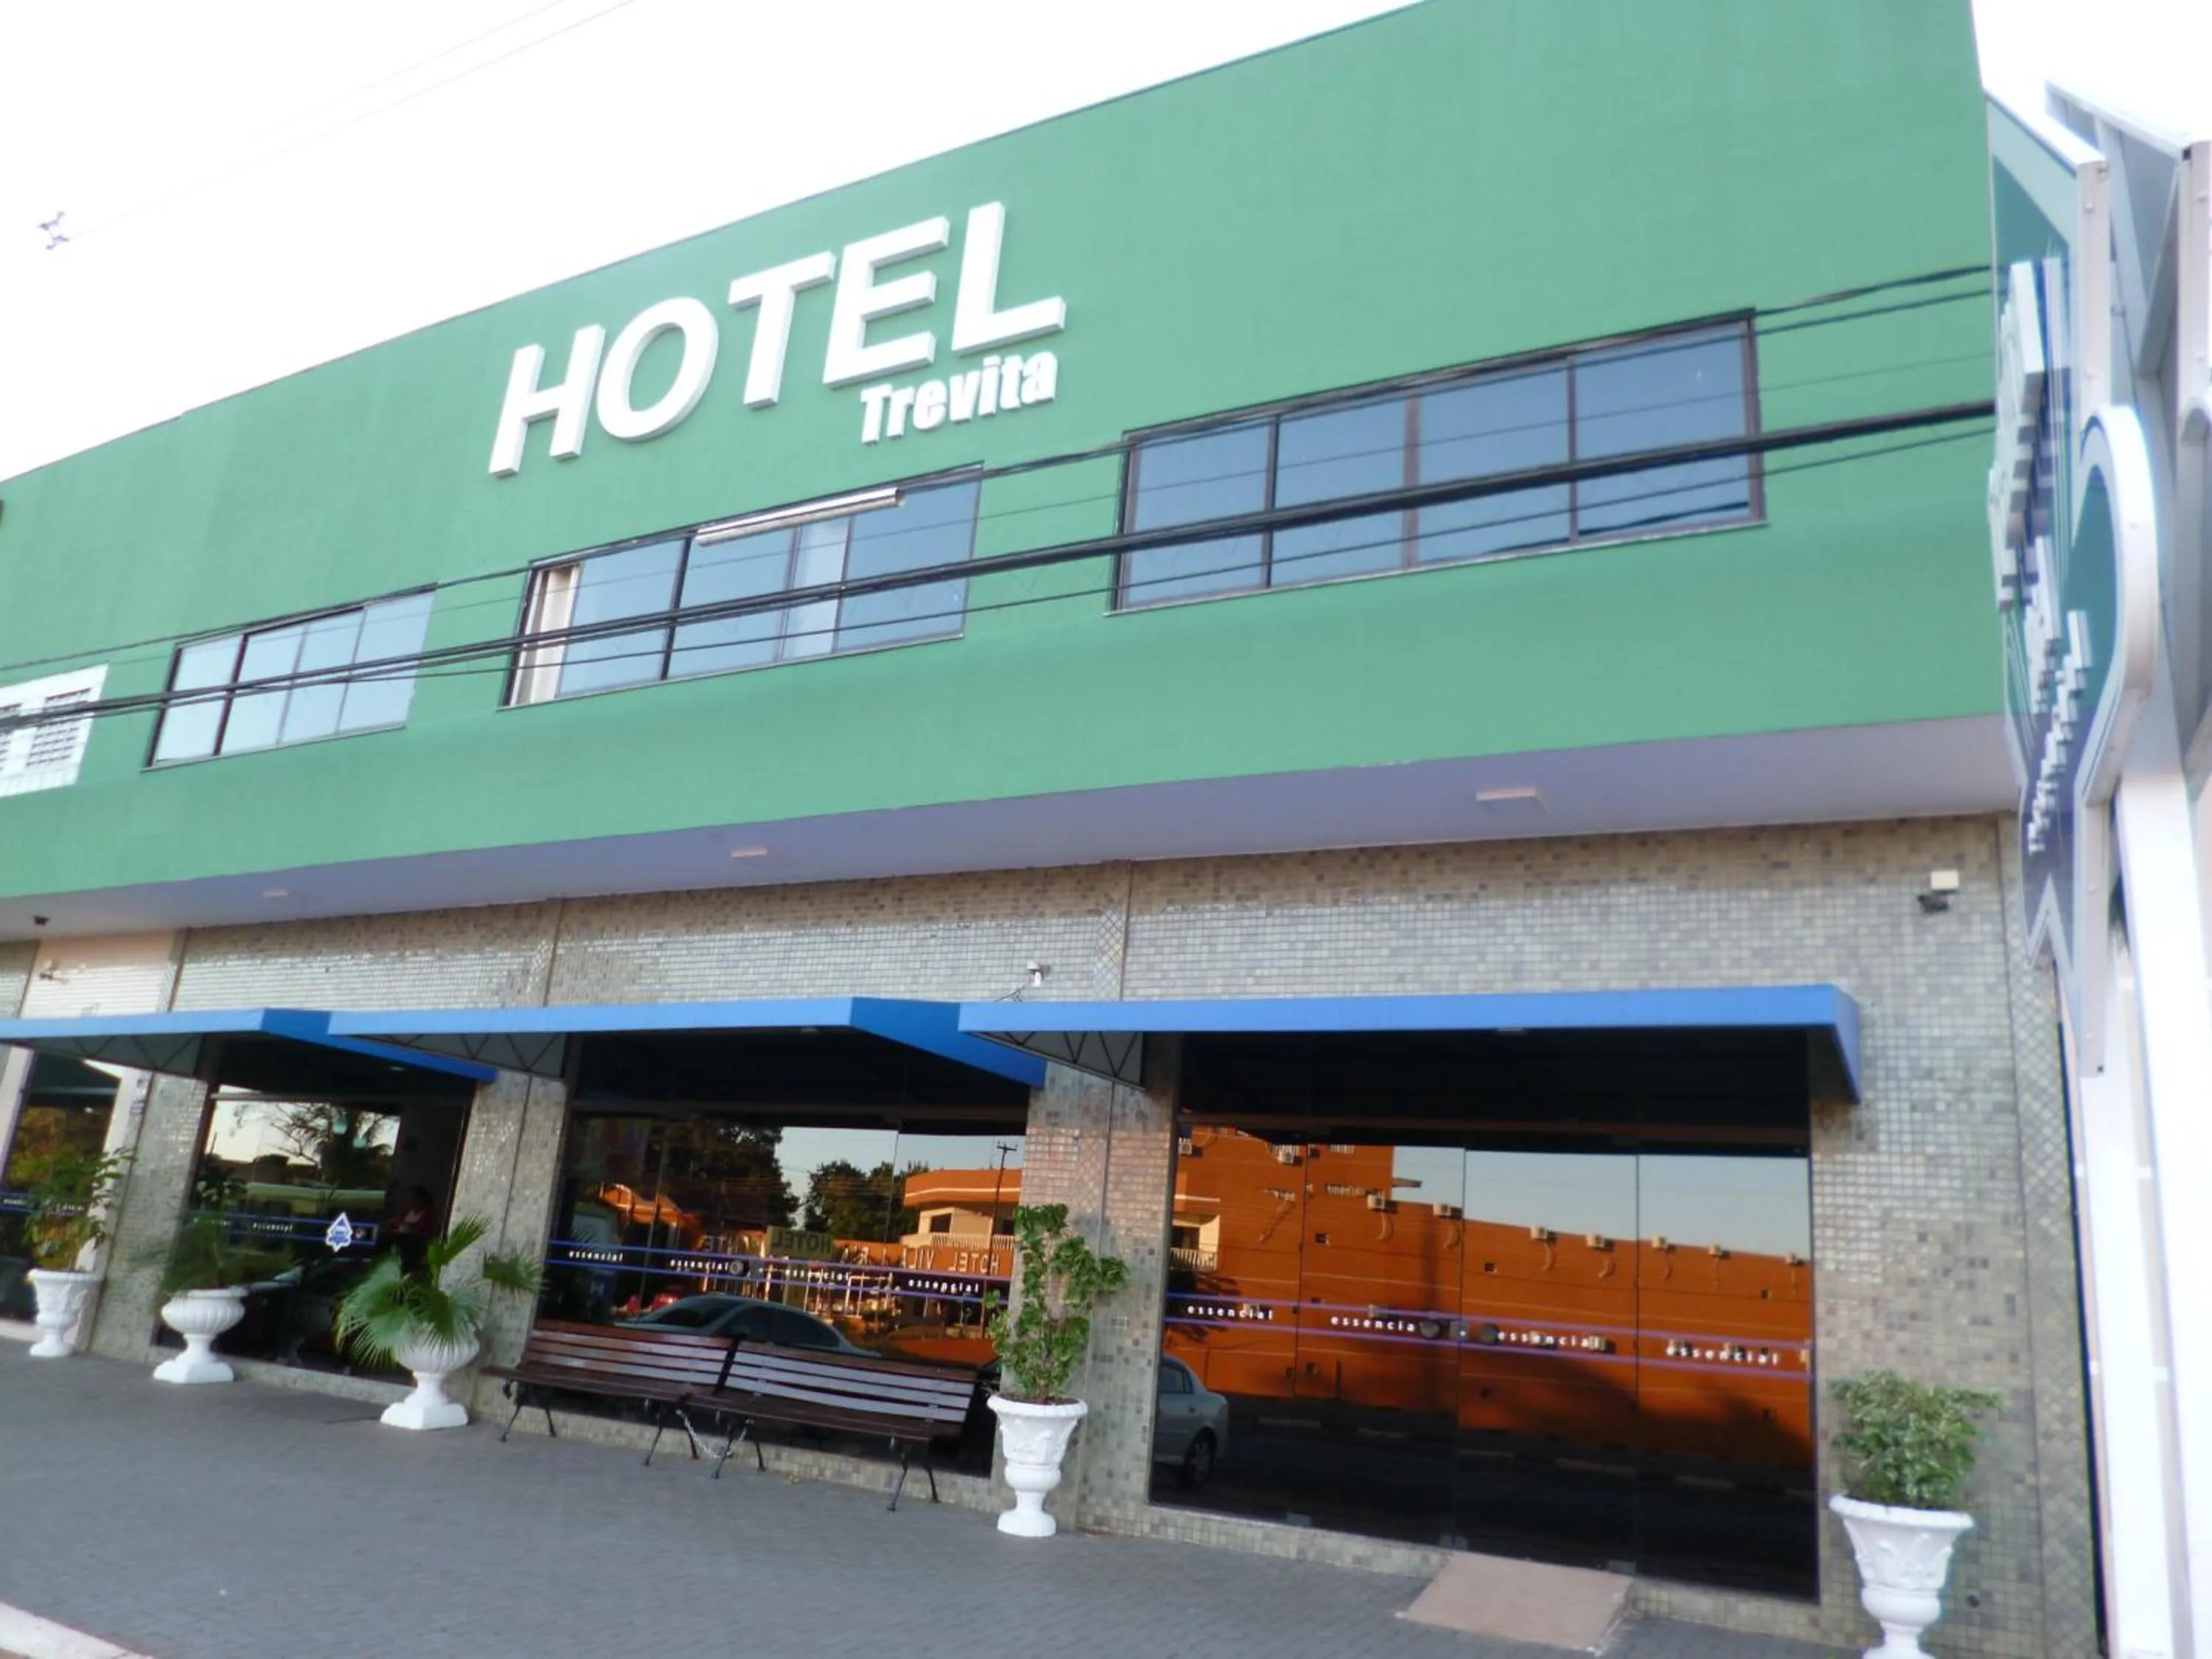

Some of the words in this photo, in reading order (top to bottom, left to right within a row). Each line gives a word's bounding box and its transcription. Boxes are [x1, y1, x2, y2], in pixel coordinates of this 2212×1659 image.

[489, 201, 1066, 477] HOTEL
[860, 351, 1058, 445] Trevita
[1187, 1304, 1274, 1320] essencial
[1331, 1315, 1423, 1332] essencia
[1498, 1330, 1600, 1349] essencial
[1666, 1345, 1778, 1365] essencial
